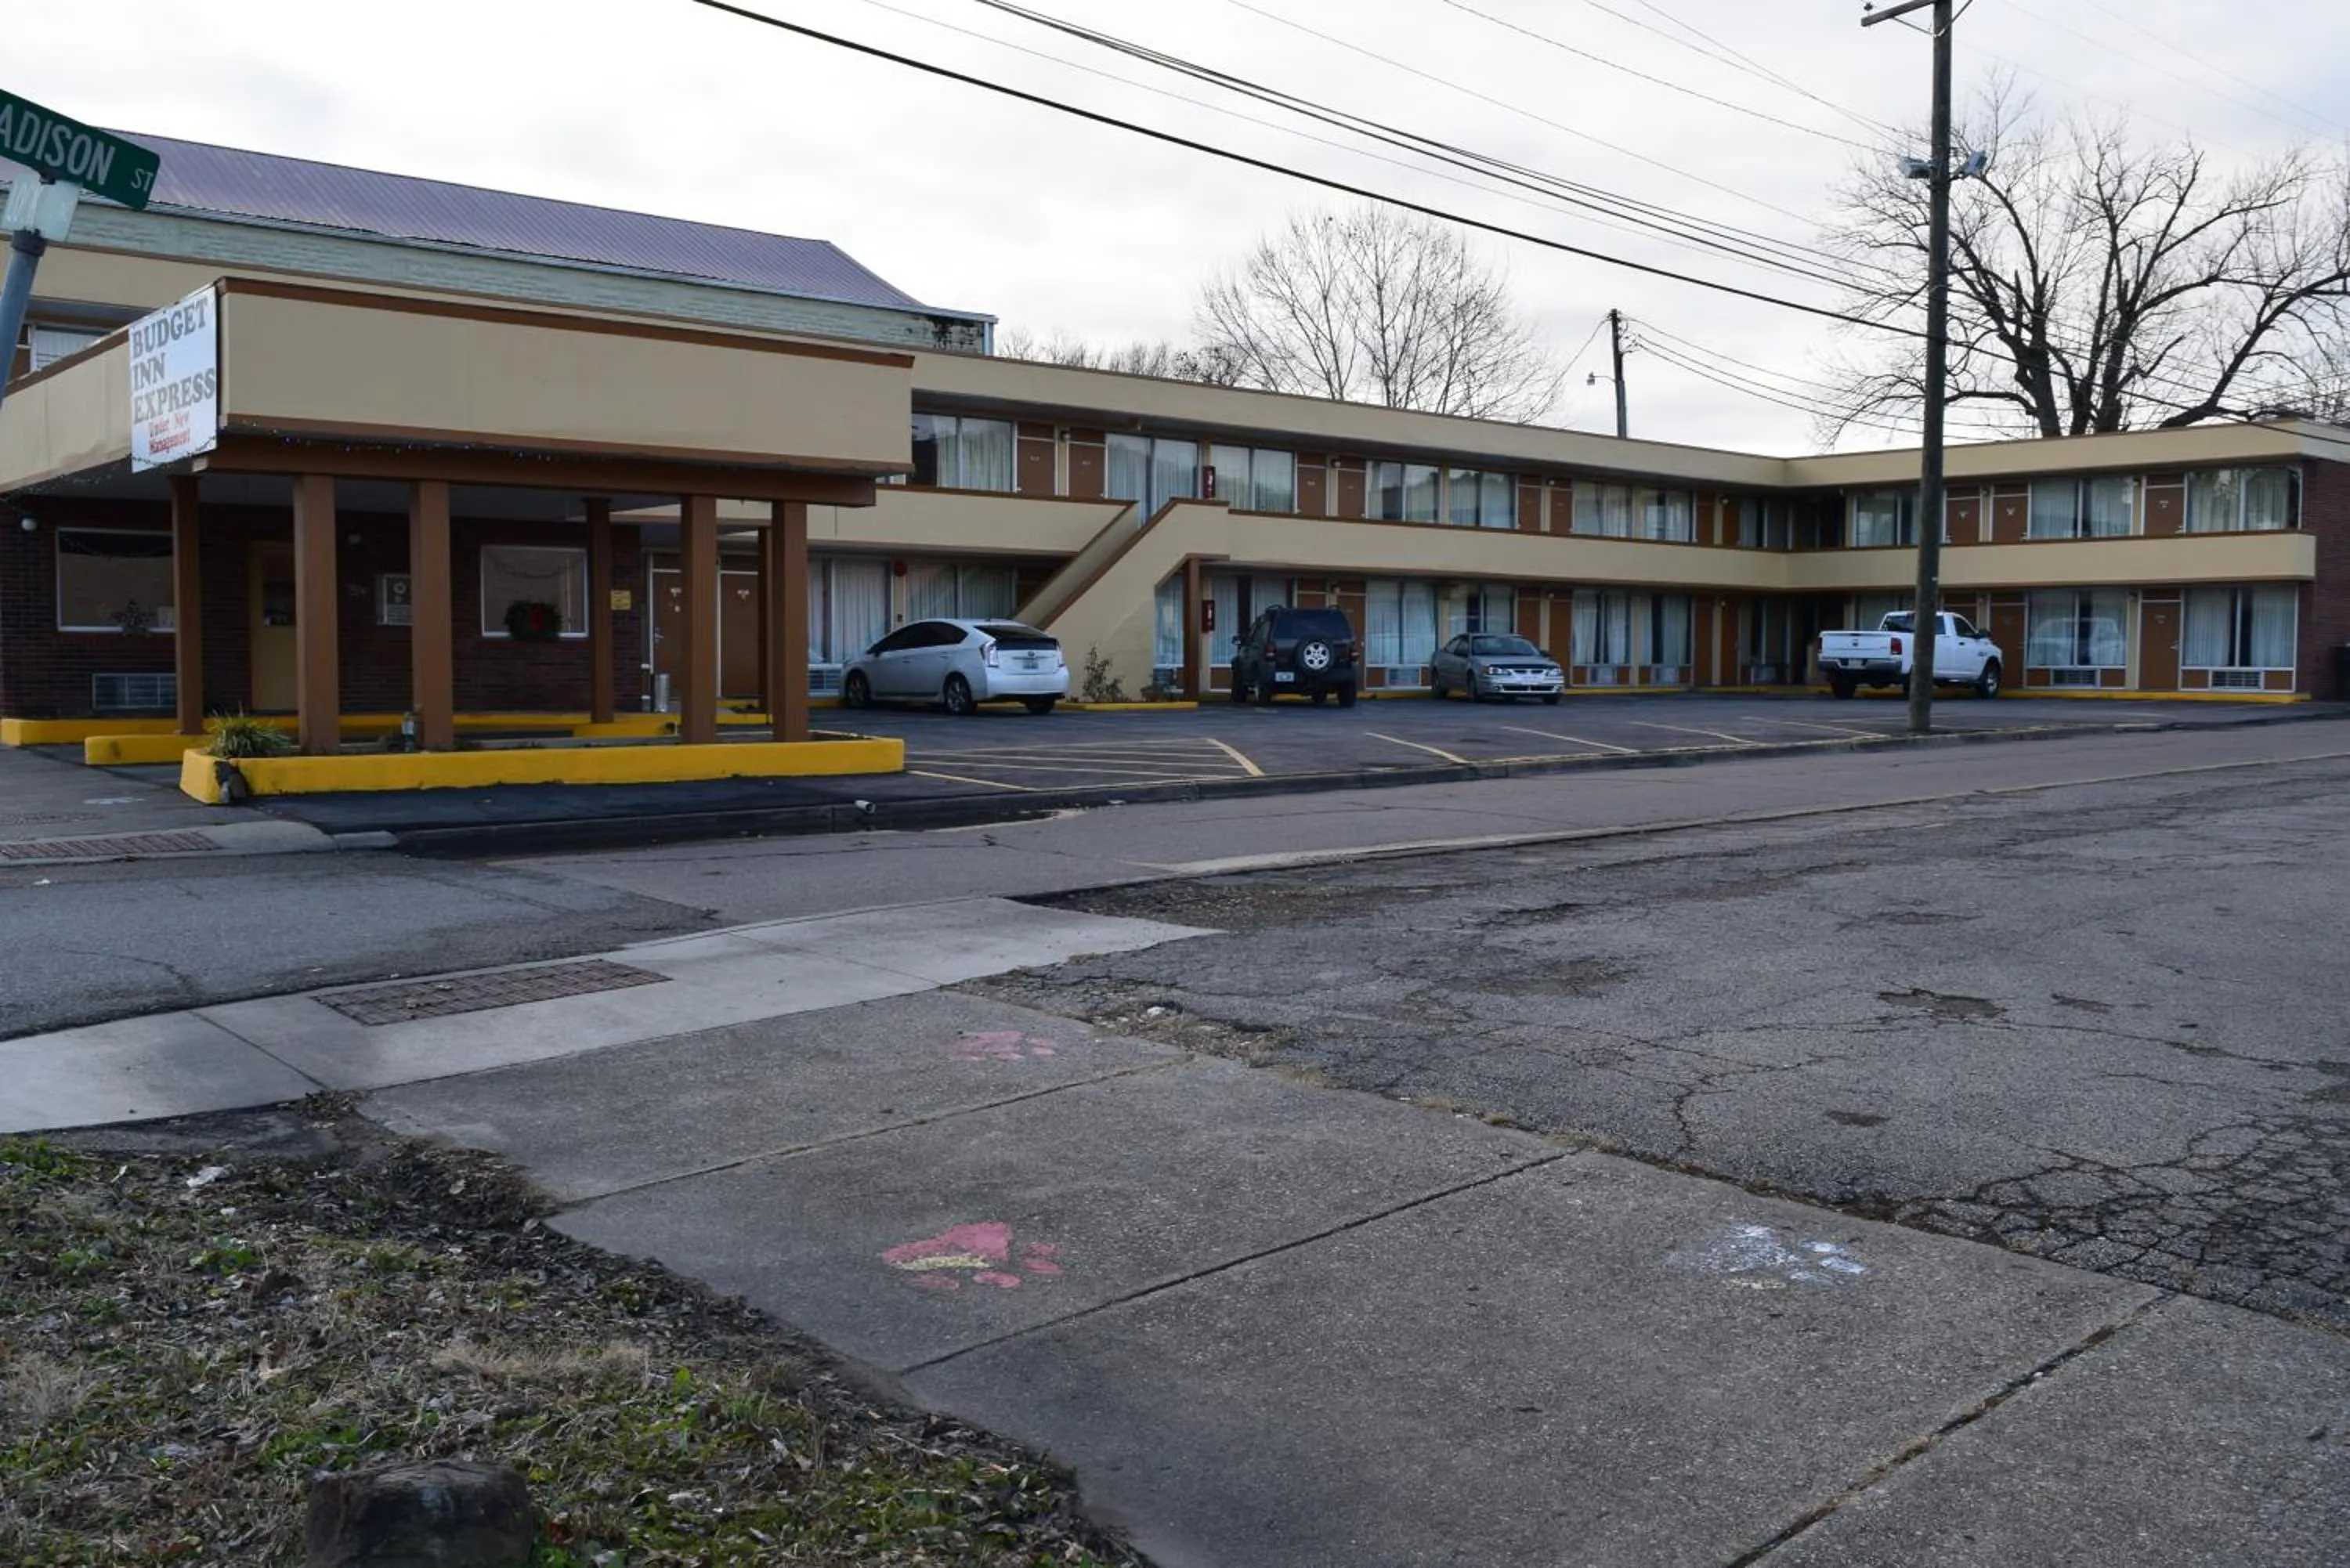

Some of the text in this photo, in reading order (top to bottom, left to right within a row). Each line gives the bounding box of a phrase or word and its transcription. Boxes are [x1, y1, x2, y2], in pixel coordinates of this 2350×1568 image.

[131, 168, 154, 191] ST
[132, 297, 208, 359] BUDGET
[133, 352, 165, 391] INN
[134, 367, 215, 424] EXPRESS
